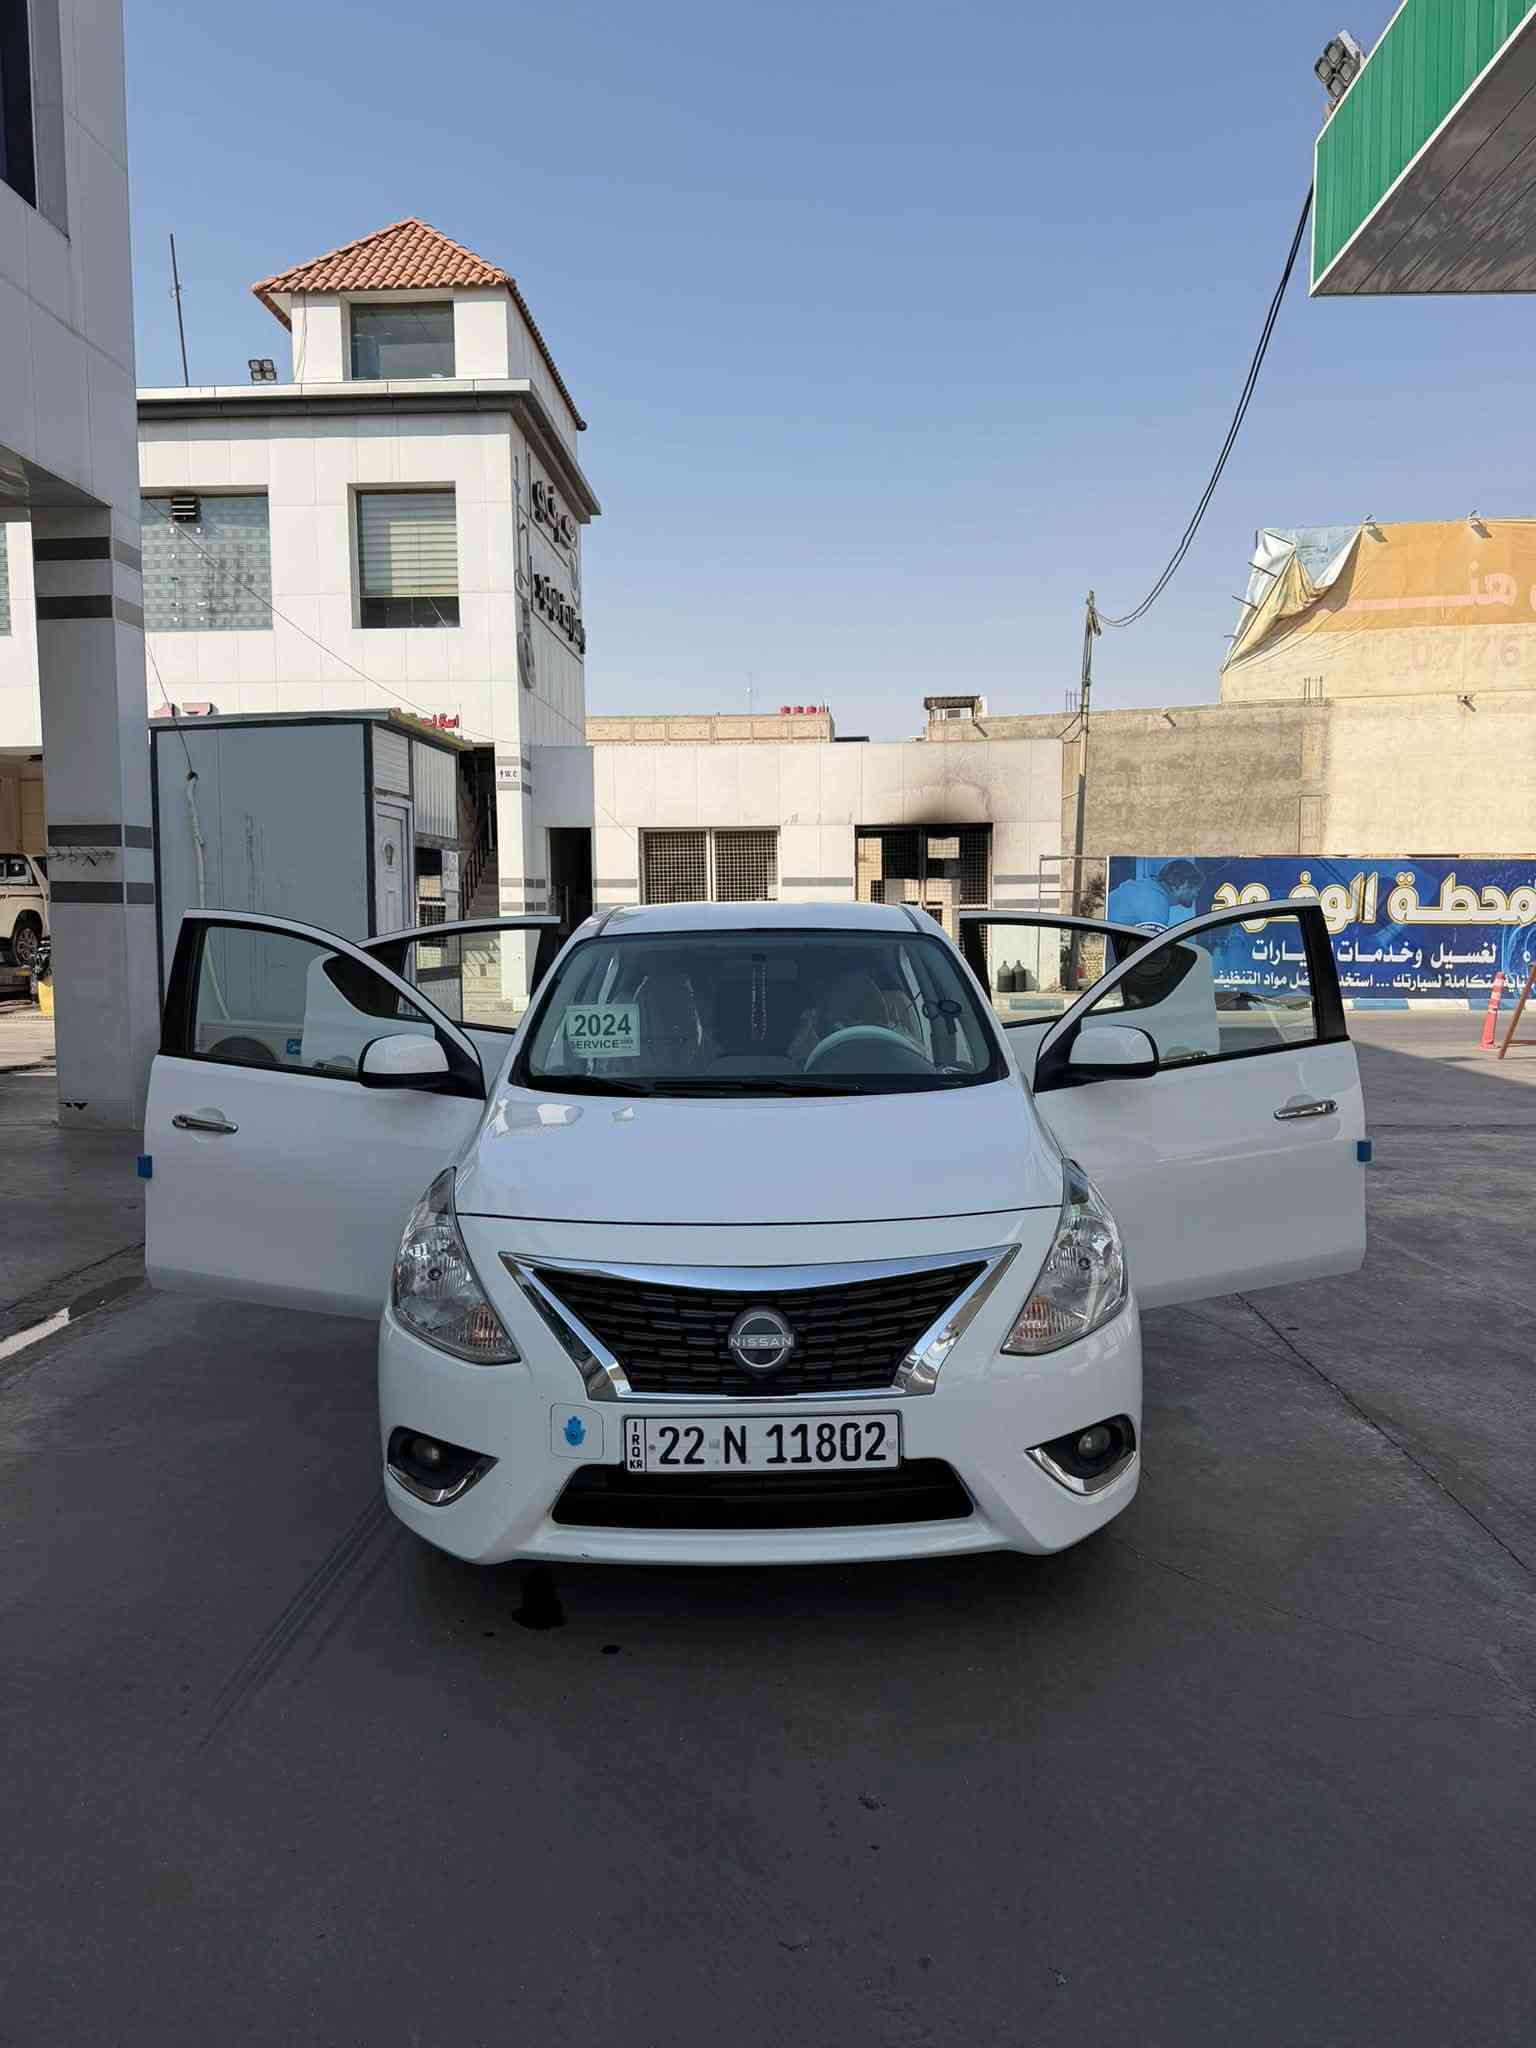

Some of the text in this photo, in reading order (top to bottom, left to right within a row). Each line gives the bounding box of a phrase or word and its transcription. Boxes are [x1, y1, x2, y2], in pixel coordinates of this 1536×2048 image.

[1211, 871, 1536, 934] محطة الوفود
[1252, 939, 1497, 968] لغسيل وخدمات يارات
[1263, 973, 1287, 988] مواد
[1338, 972, 1372, 987] استخد
[1392, 973, 1441, 991] لسيارتك
[1444, 973, 1492, 988] تكاملة
[1503, 972, 1532, 993] ناية
[574, 1013, 632, 1036] 2024
[568, 1039, 619, 1050] ERVICE
[730, 1336, 792, 1347] NISSAN
[658, 1421, 887, 1465] 22 N 11802
